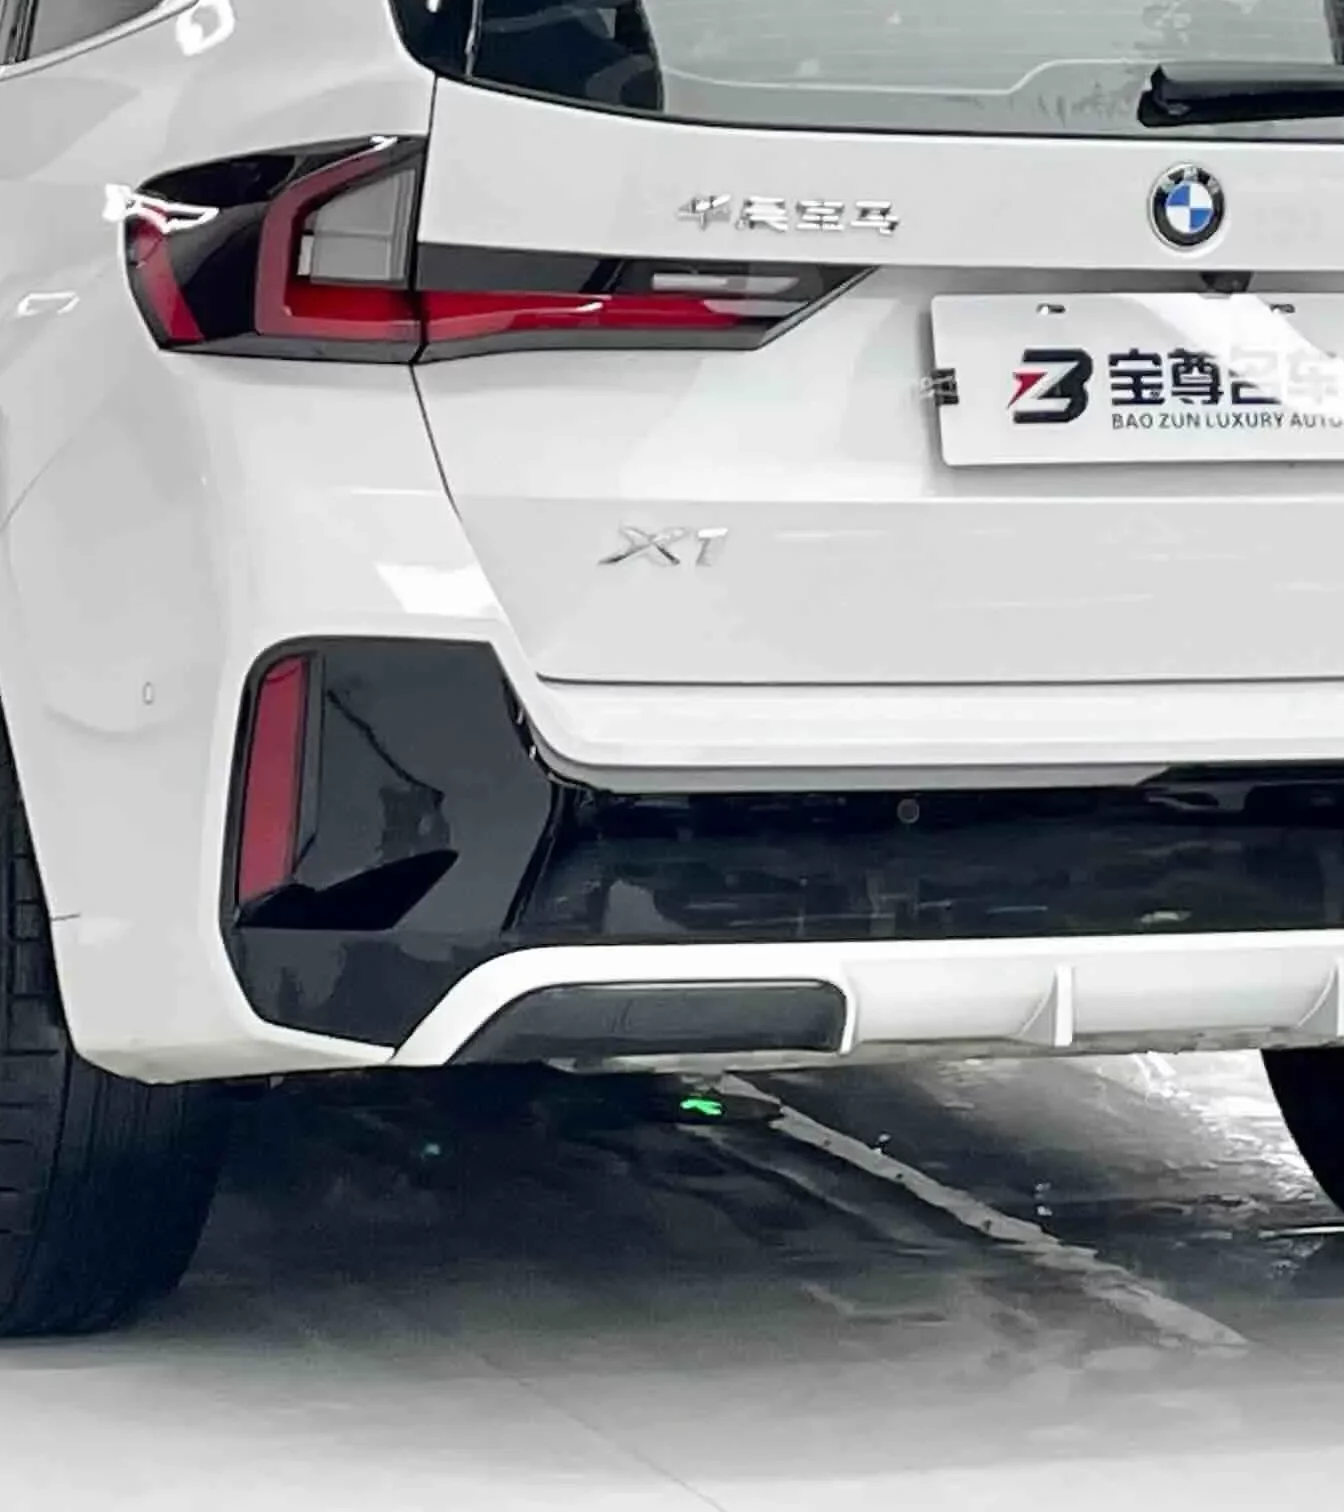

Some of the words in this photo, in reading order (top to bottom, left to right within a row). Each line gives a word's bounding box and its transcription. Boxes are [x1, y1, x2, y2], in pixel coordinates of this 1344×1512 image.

[1108, 347, 1341, 406] 宝尊名车
[1112, 412, 1153, 430] BAO
[1158, 412, 1202, 430] ZUN
[1206, 412, 1285, 430] LUXURY
[596, 525, 729, 567] X1
